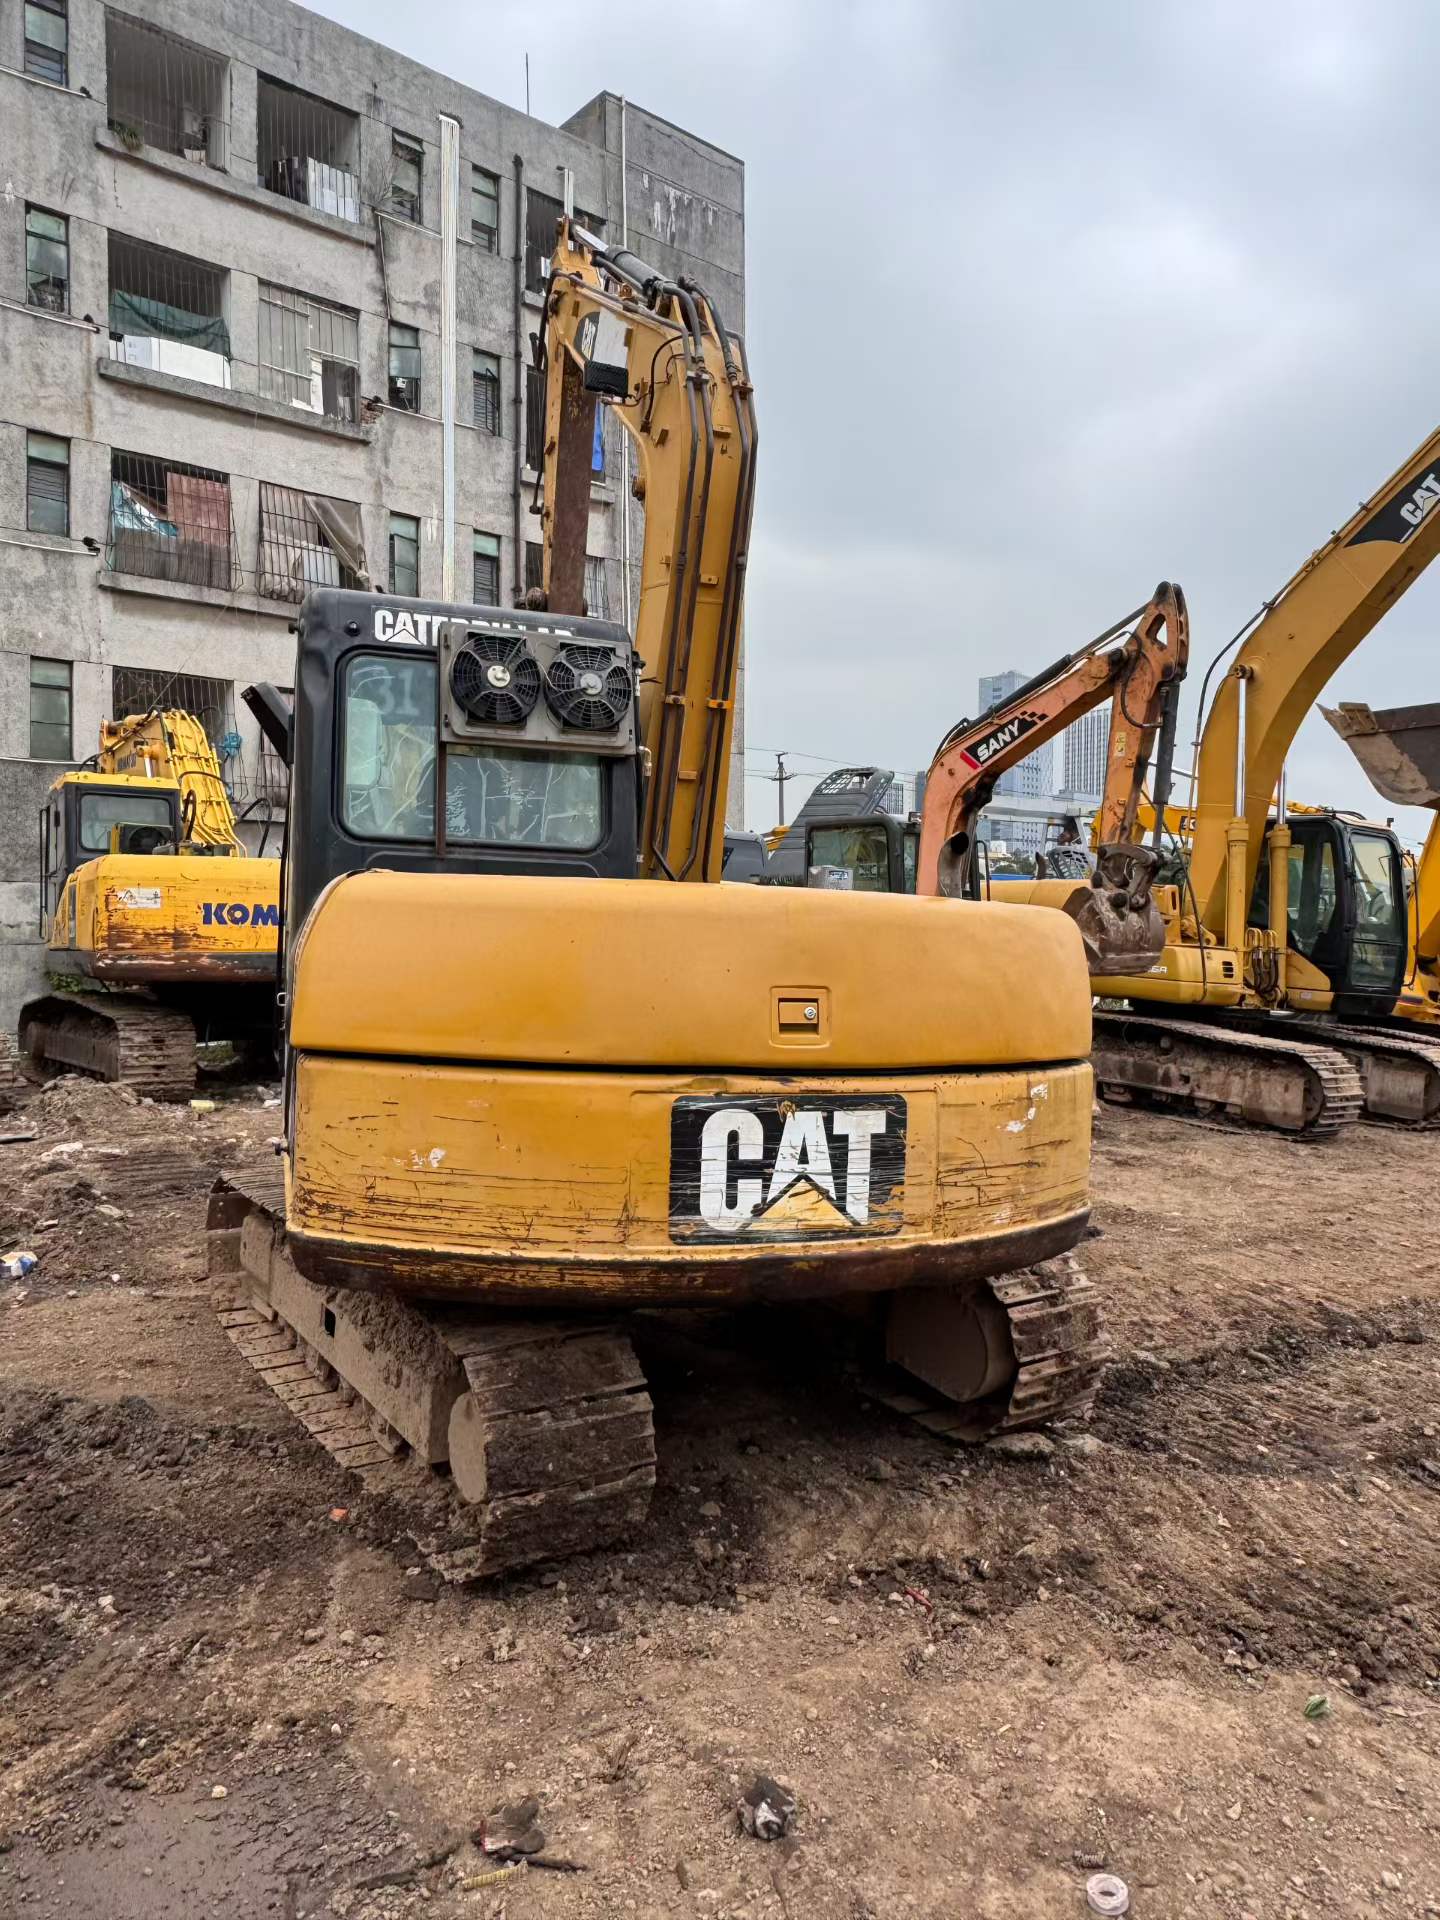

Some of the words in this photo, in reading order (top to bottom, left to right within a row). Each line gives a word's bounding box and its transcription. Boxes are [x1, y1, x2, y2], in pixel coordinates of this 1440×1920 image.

[1400, 473, 1440, 525] CAT
[977, 719, 1019, 763] SANY
[700, 1109, 886, 1231] CAT
